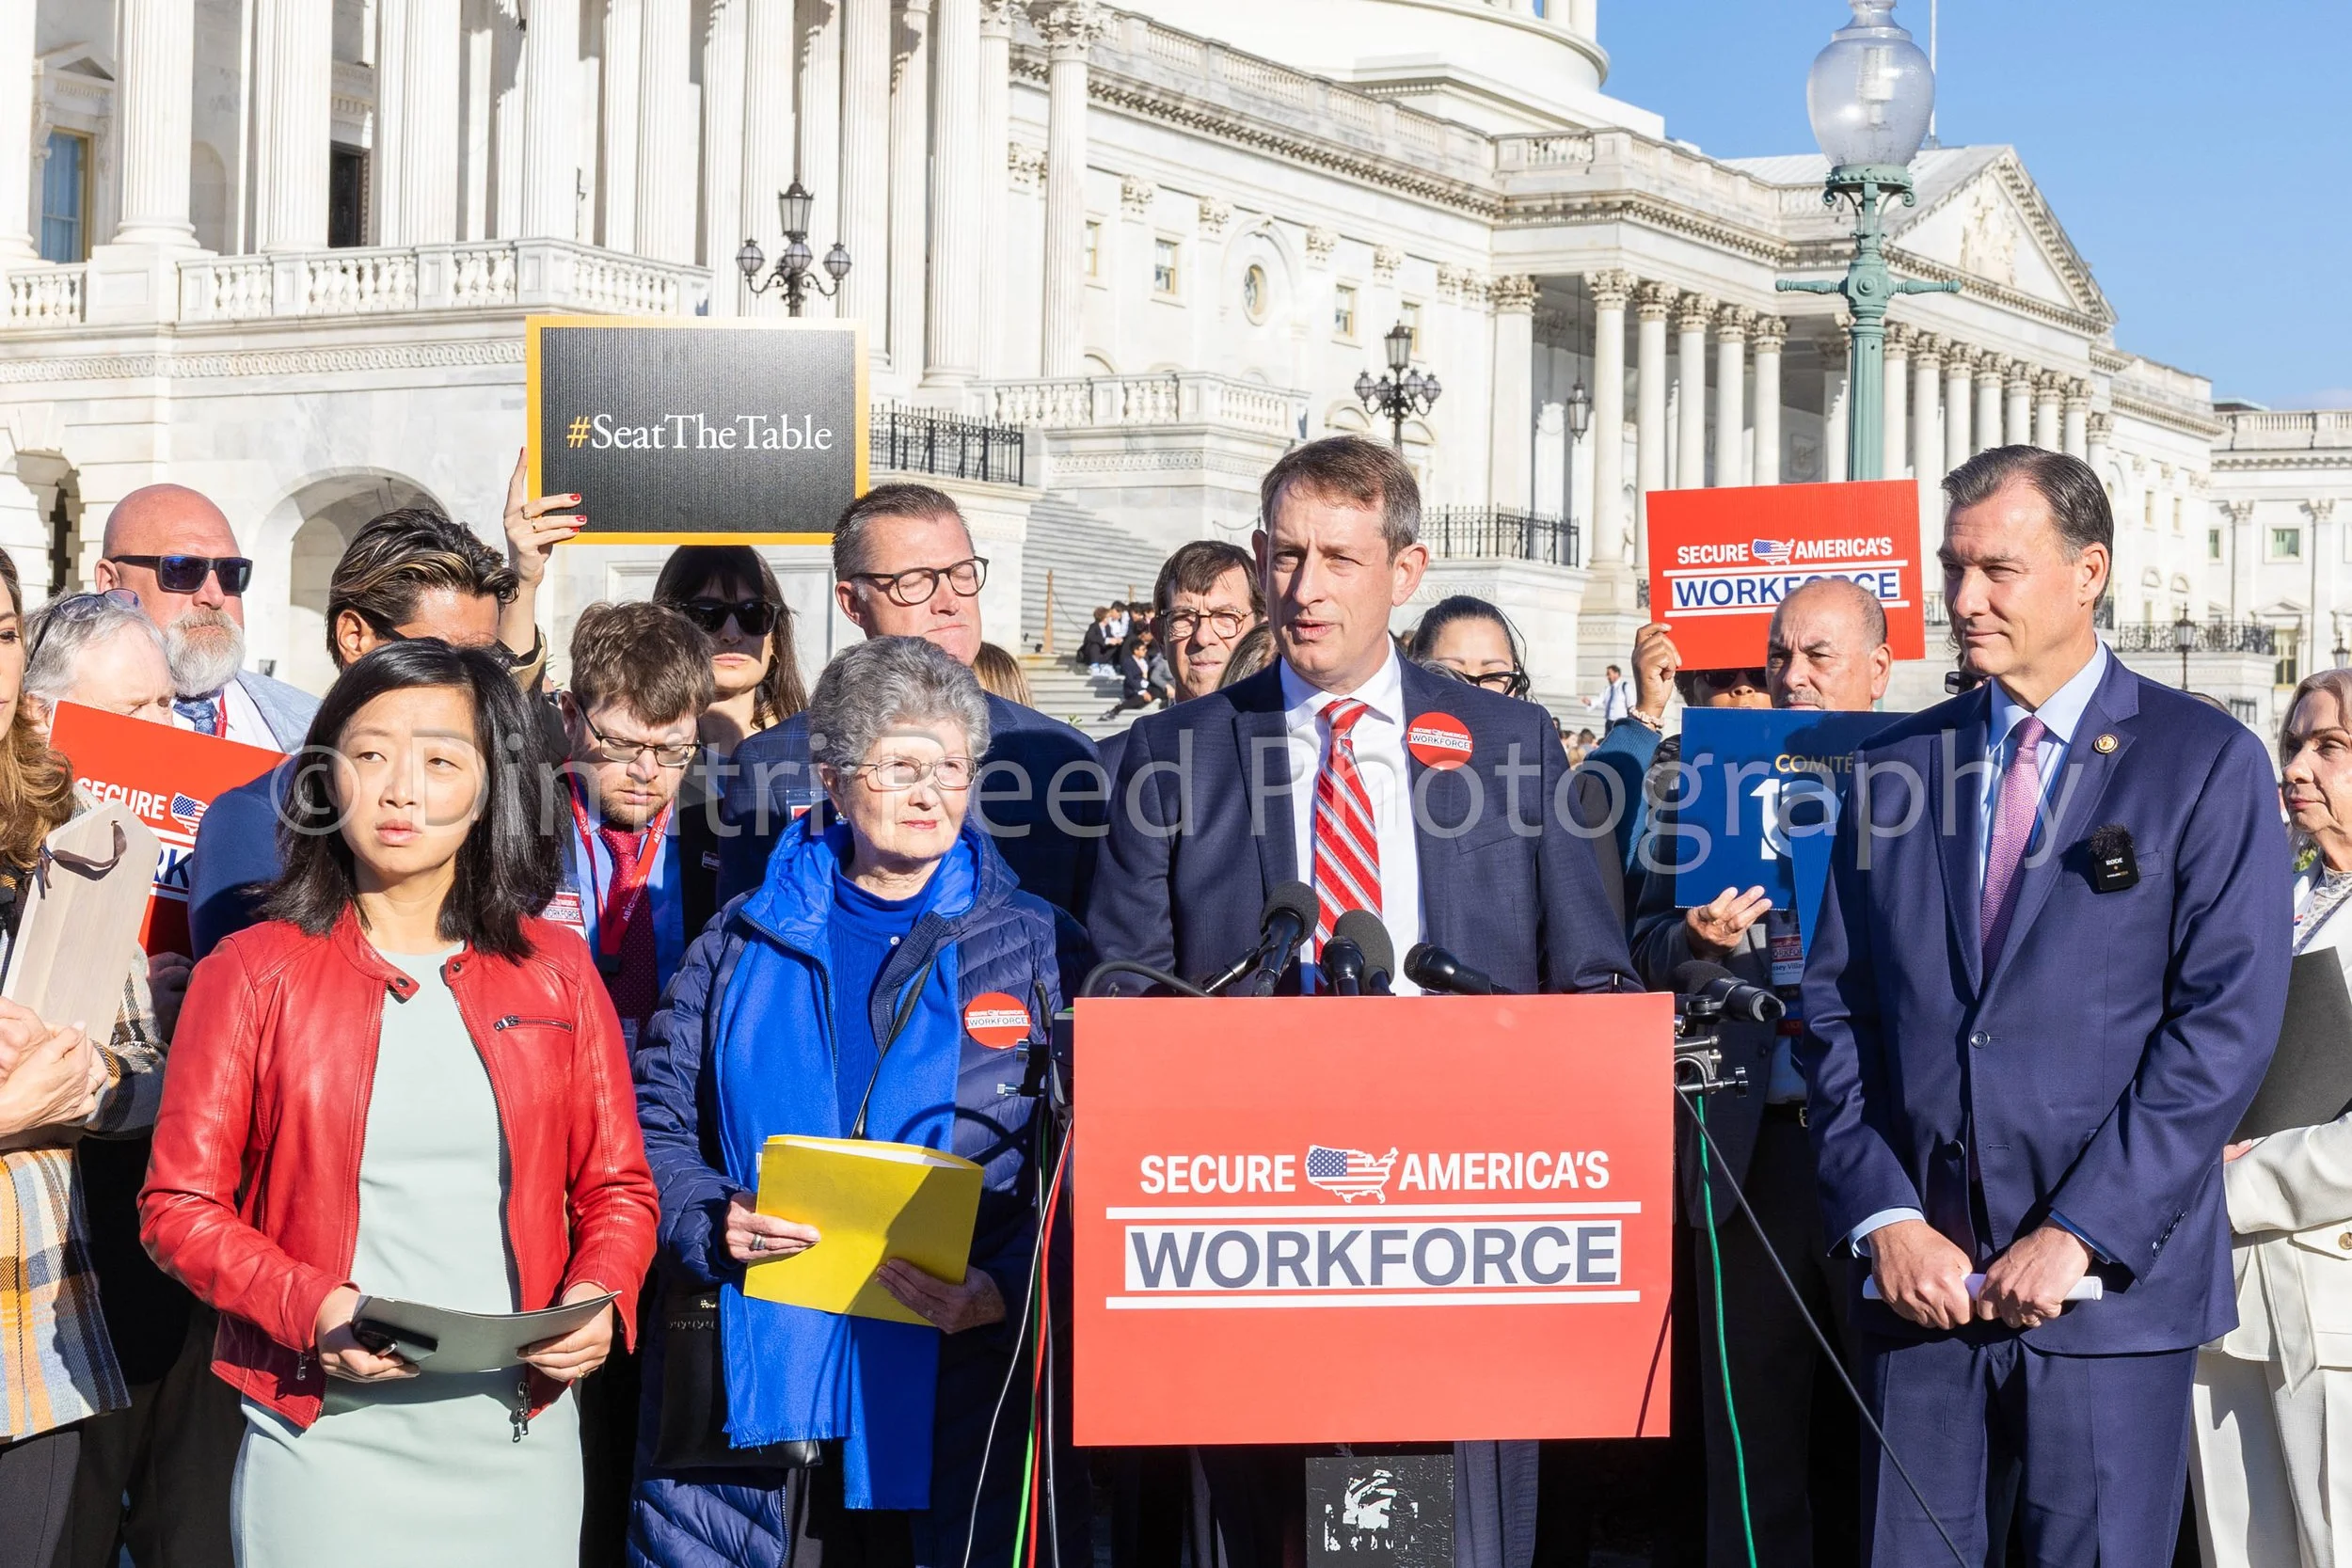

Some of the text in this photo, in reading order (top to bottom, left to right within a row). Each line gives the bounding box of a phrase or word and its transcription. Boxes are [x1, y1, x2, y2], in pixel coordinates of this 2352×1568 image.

[565, 412, 834, 450] #SeatTheTable
[1677, 537, 1893, 564] SECURE AMERICA'S
[1412, 736, 1469, 749] WORKFORCE
[1774, 752, 1854, 774] COMITÉ
[970, 1017, 1026, 1026] WORKFORCE
[1139, 1150, 1611, 1195] SECURE AMERICA'S
[1131, 1226, 1616, 1289] WORKFORCE
